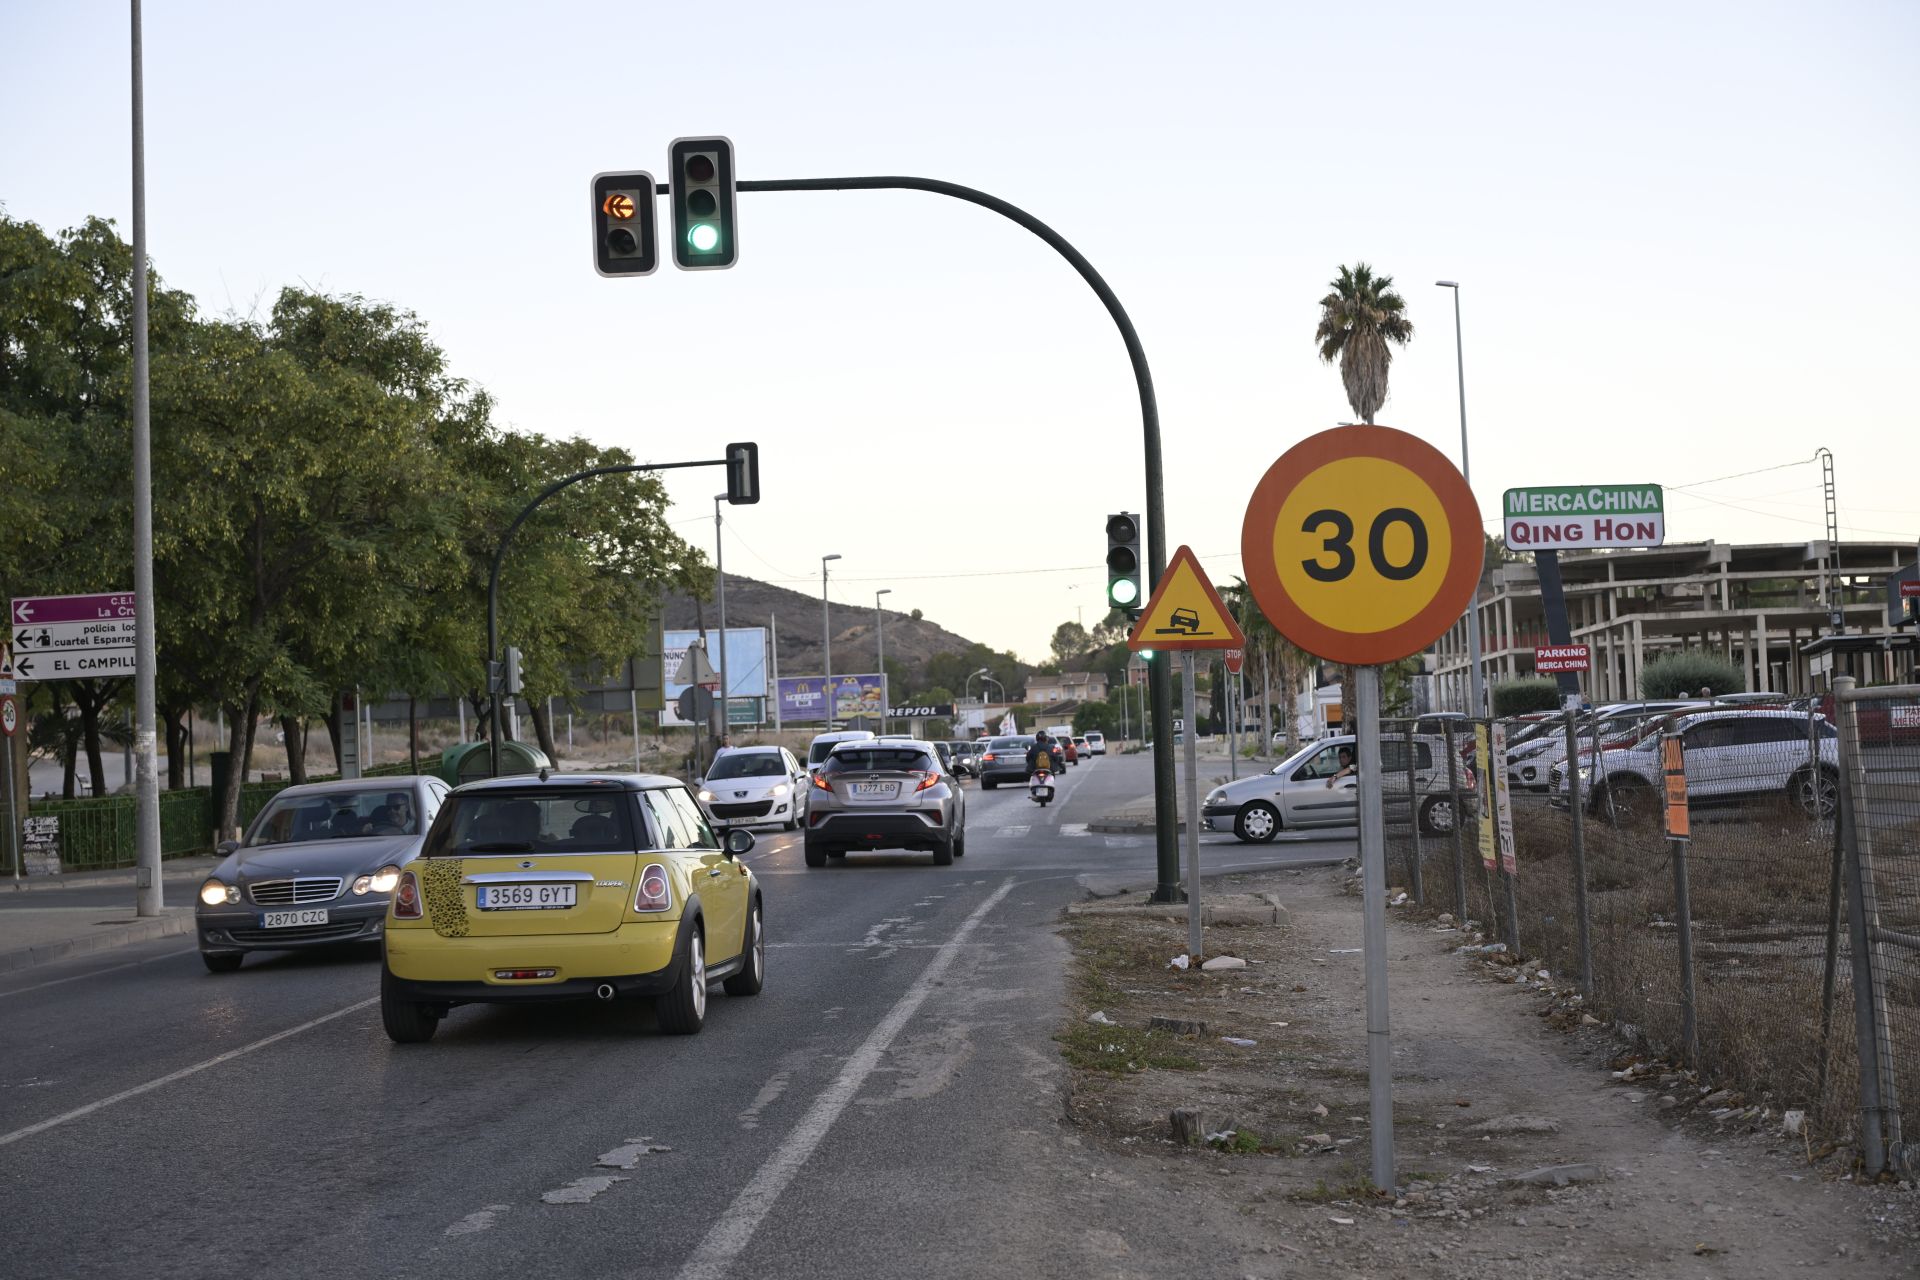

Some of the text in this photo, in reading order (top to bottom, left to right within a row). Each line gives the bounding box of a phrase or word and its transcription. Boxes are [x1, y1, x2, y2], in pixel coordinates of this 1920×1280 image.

[1510, 518, 1656, 544] QING HON
[1301, 507, 1429, 583] 30
[98, 607, 112, 617] La
[54, 637, 89, 647] cuartel
[1226, 649, 1242, 660] STOP
[1537, 647, 1587, 658] PARKING
[54, 660, 71, 671] EL
[1537, 660, 1588, 670] MERCA CHINA
[887, 706, 937, 717] REPSOL
[490, 886, 572, 904] 3569 GYT
[267, 911, 325, 926] 2870 CZC
